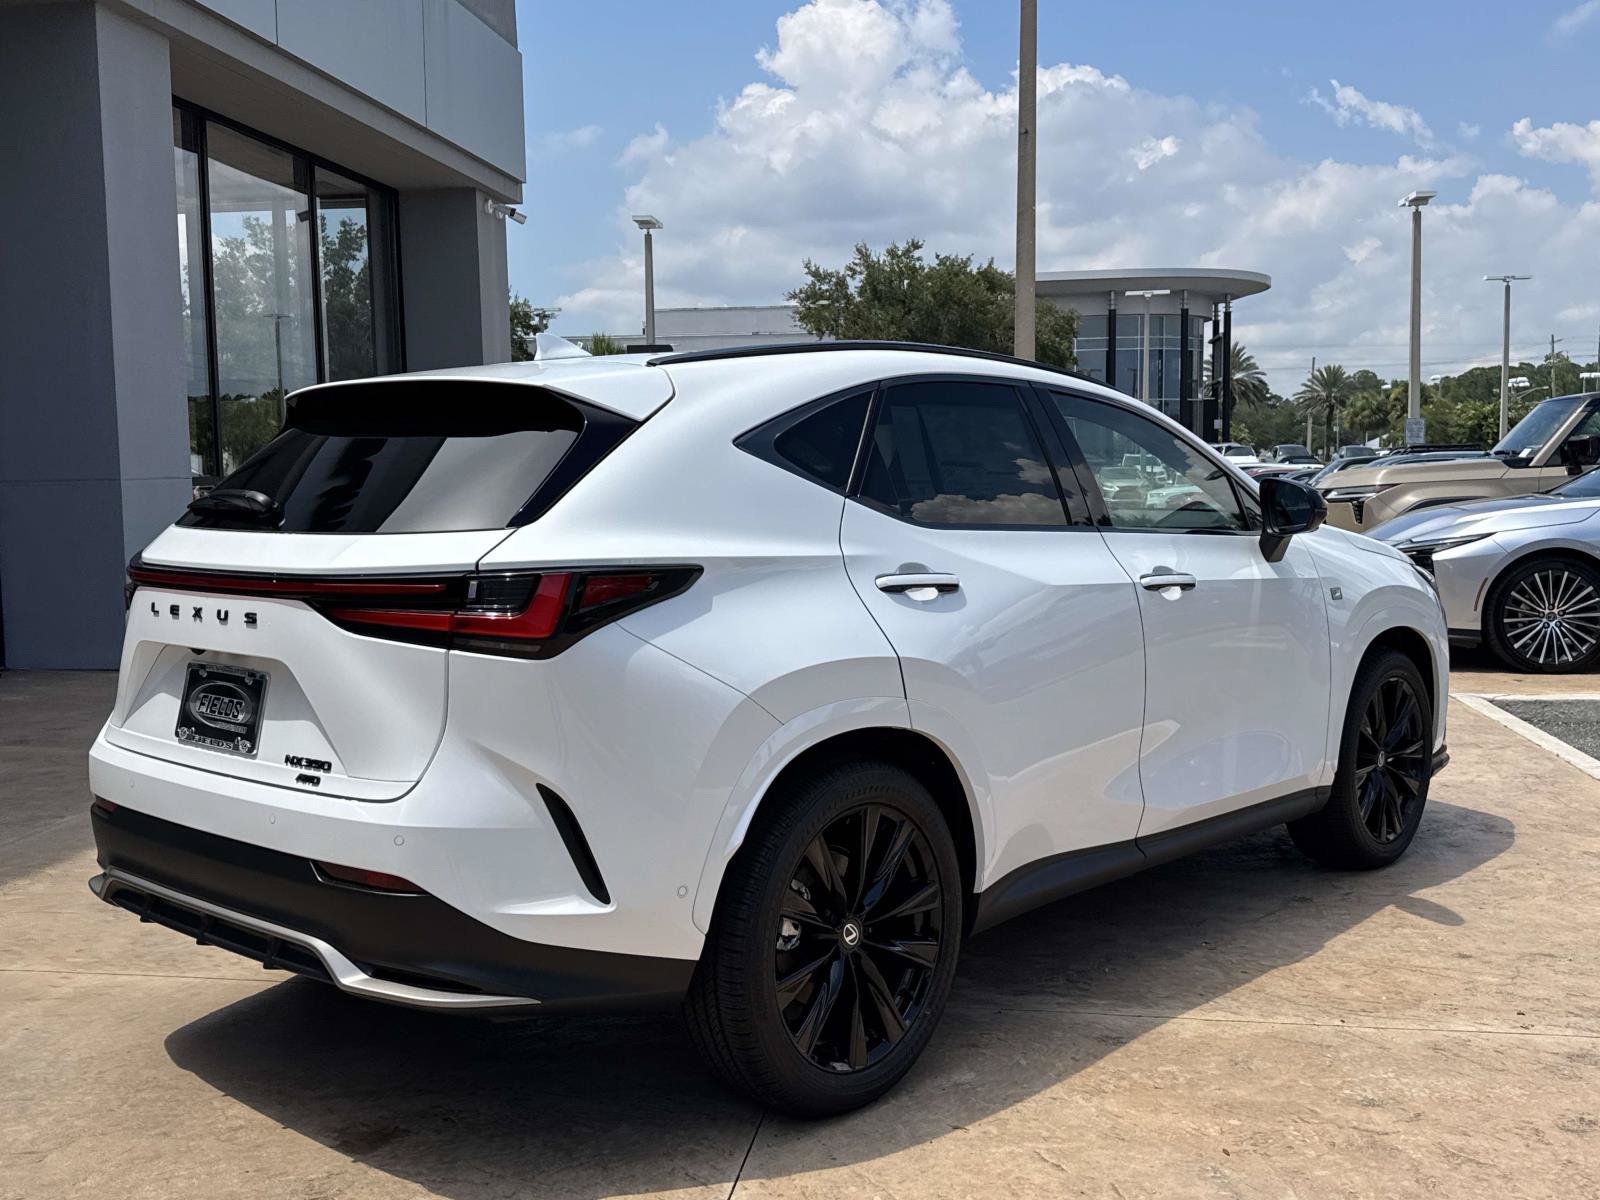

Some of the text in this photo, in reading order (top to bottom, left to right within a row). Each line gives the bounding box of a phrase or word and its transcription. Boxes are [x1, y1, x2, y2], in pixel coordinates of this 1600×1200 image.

[151, 602, 258, 626] LEXUS
[198, 694, 244, 719] FIELDS
[192, 735, 234, 751] FIELDS
